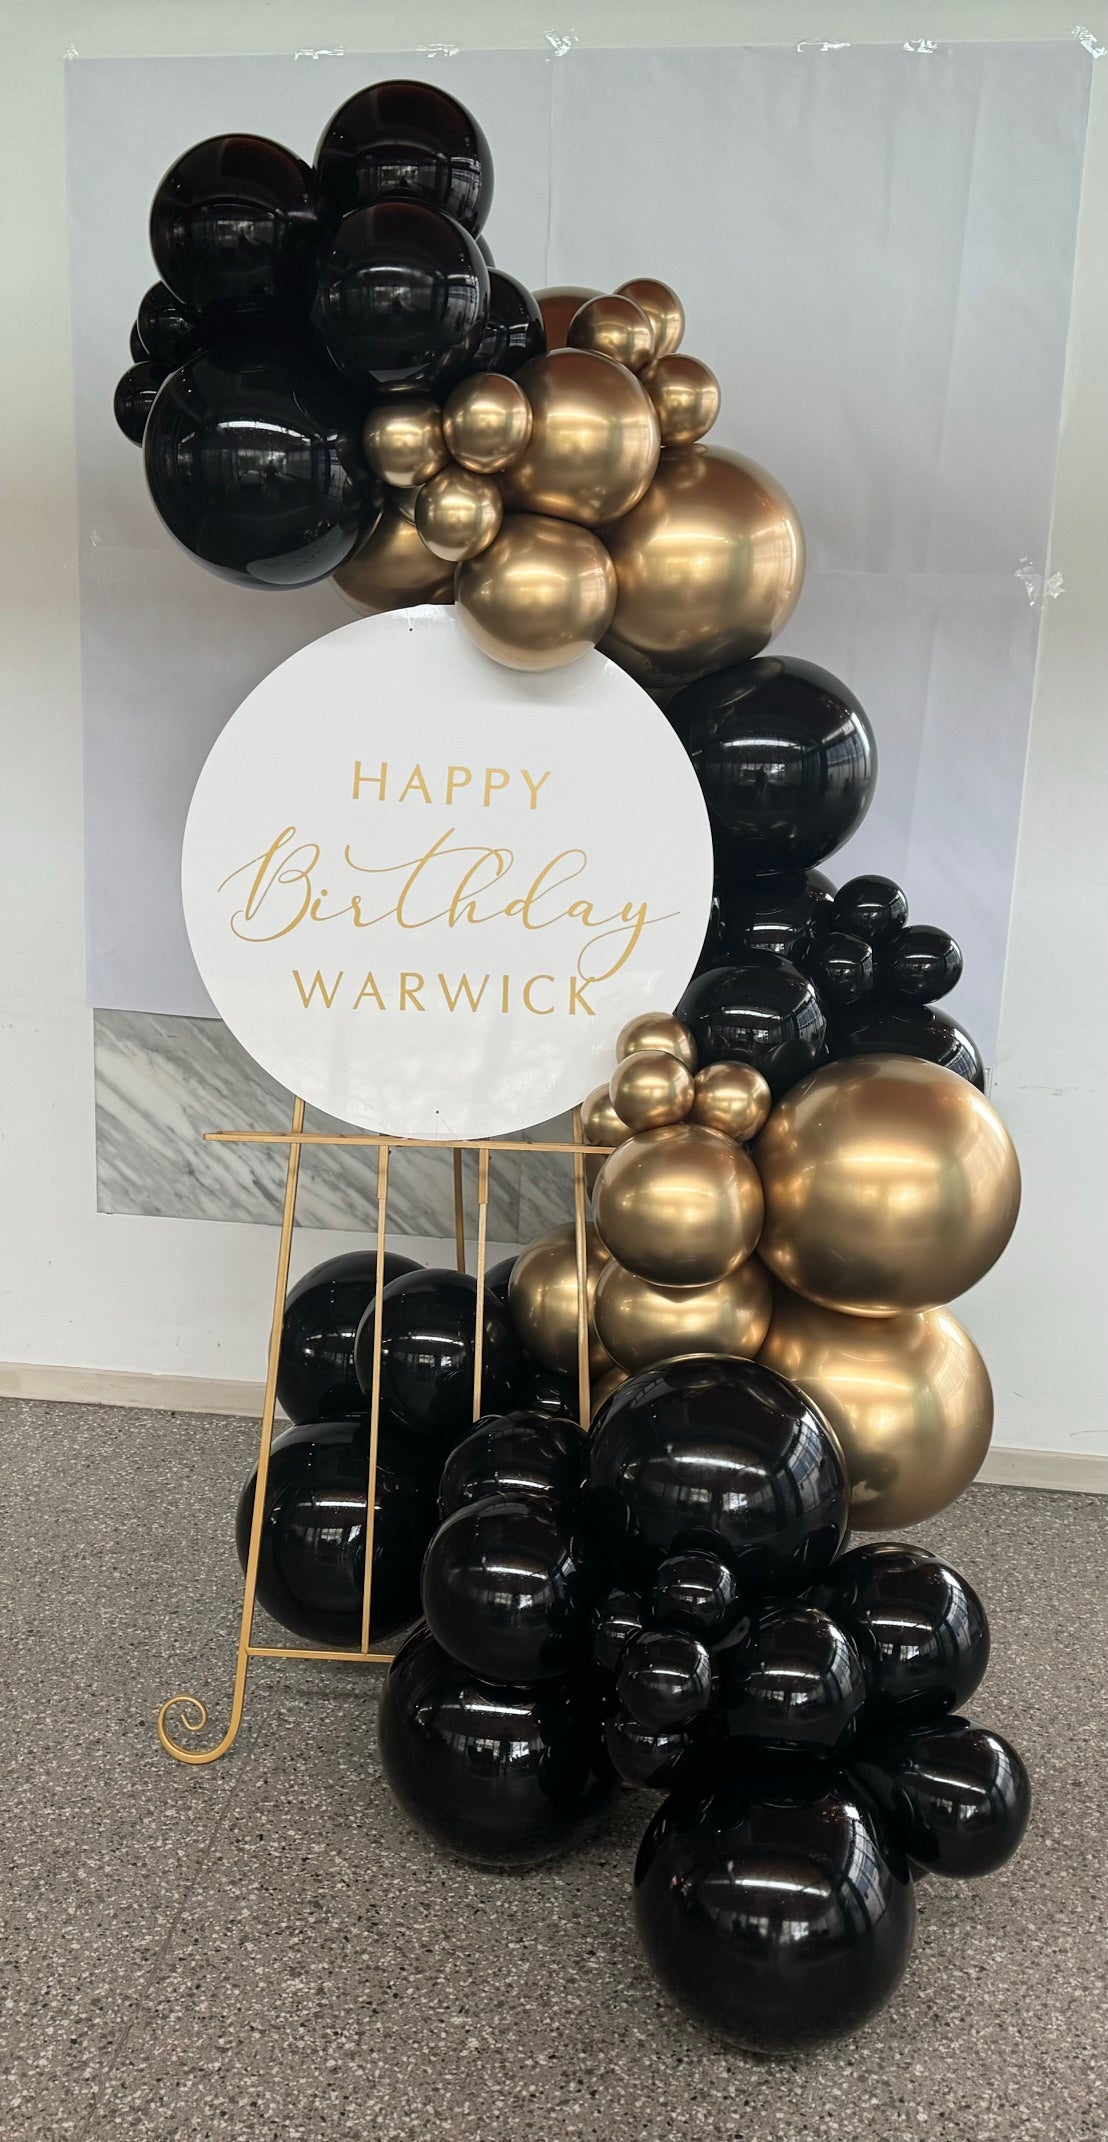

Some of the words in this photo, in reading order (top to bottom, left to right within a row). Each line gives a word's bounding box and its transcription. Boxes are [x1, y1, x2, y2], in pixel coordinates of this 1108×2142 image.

[351, 760, 552, 810] HAPPY
[217, 826, 681, 982] Birthday
[292, 969, 597, 1016] WARWICK
